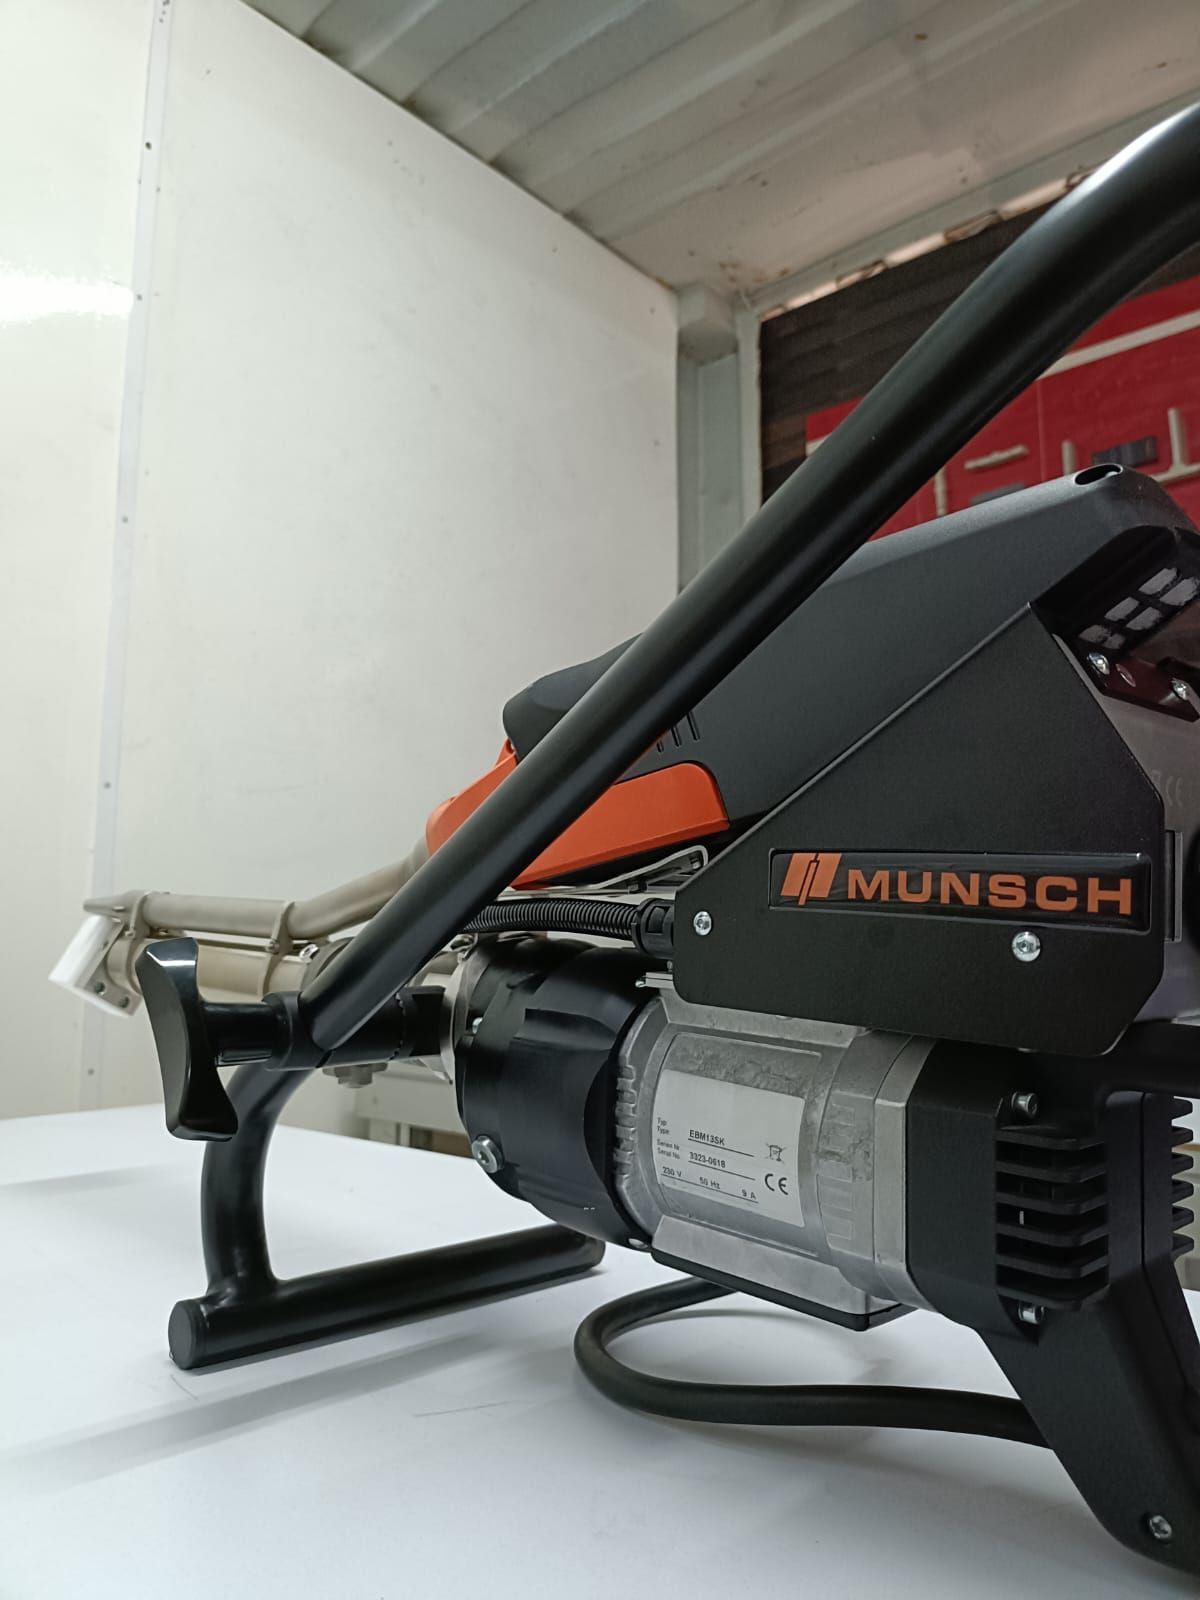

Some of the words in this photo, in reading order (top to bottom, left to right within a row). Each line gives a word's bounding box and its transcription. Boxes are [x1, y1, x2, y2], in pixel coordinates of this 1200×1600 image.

[847, 869, 1132, 916] MUNSCH
[689, 1129, 725, 1147] EBM13SK
[662, 1166, 675, 1176] 230
[699, 1176, 708, 1186] 50
[710, 1180, 720, 1189] Hz
[742, 1189, 747, 1197] 9
